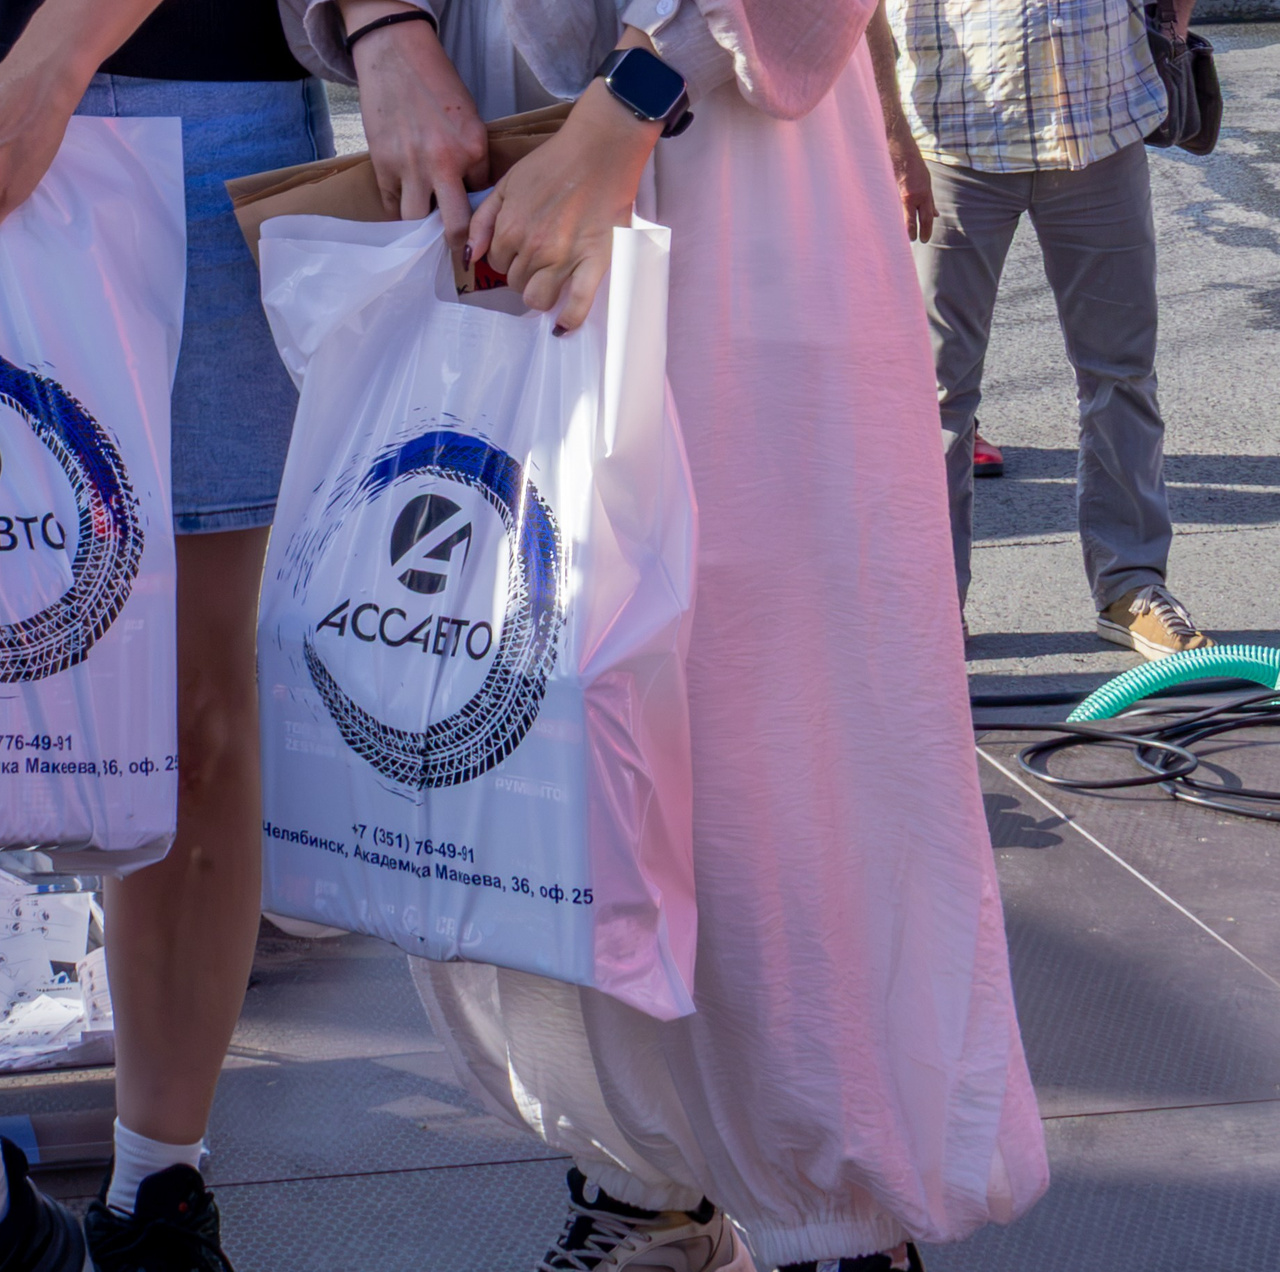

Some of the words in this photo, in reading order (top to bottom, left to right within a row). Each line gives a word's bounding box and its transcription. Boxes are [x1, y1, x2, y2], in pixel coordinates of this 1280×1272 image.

[25, 757, 101, 778] Макеева,
[128, 756, 160, 777] оф.
[351, 824, 368, 839] +7
[373, 826, 410, 854] (351)
[511, 876, 535, 898] 36,
[540, 883, 569, 904] оф.
[572, 888, 594, 905] 25
